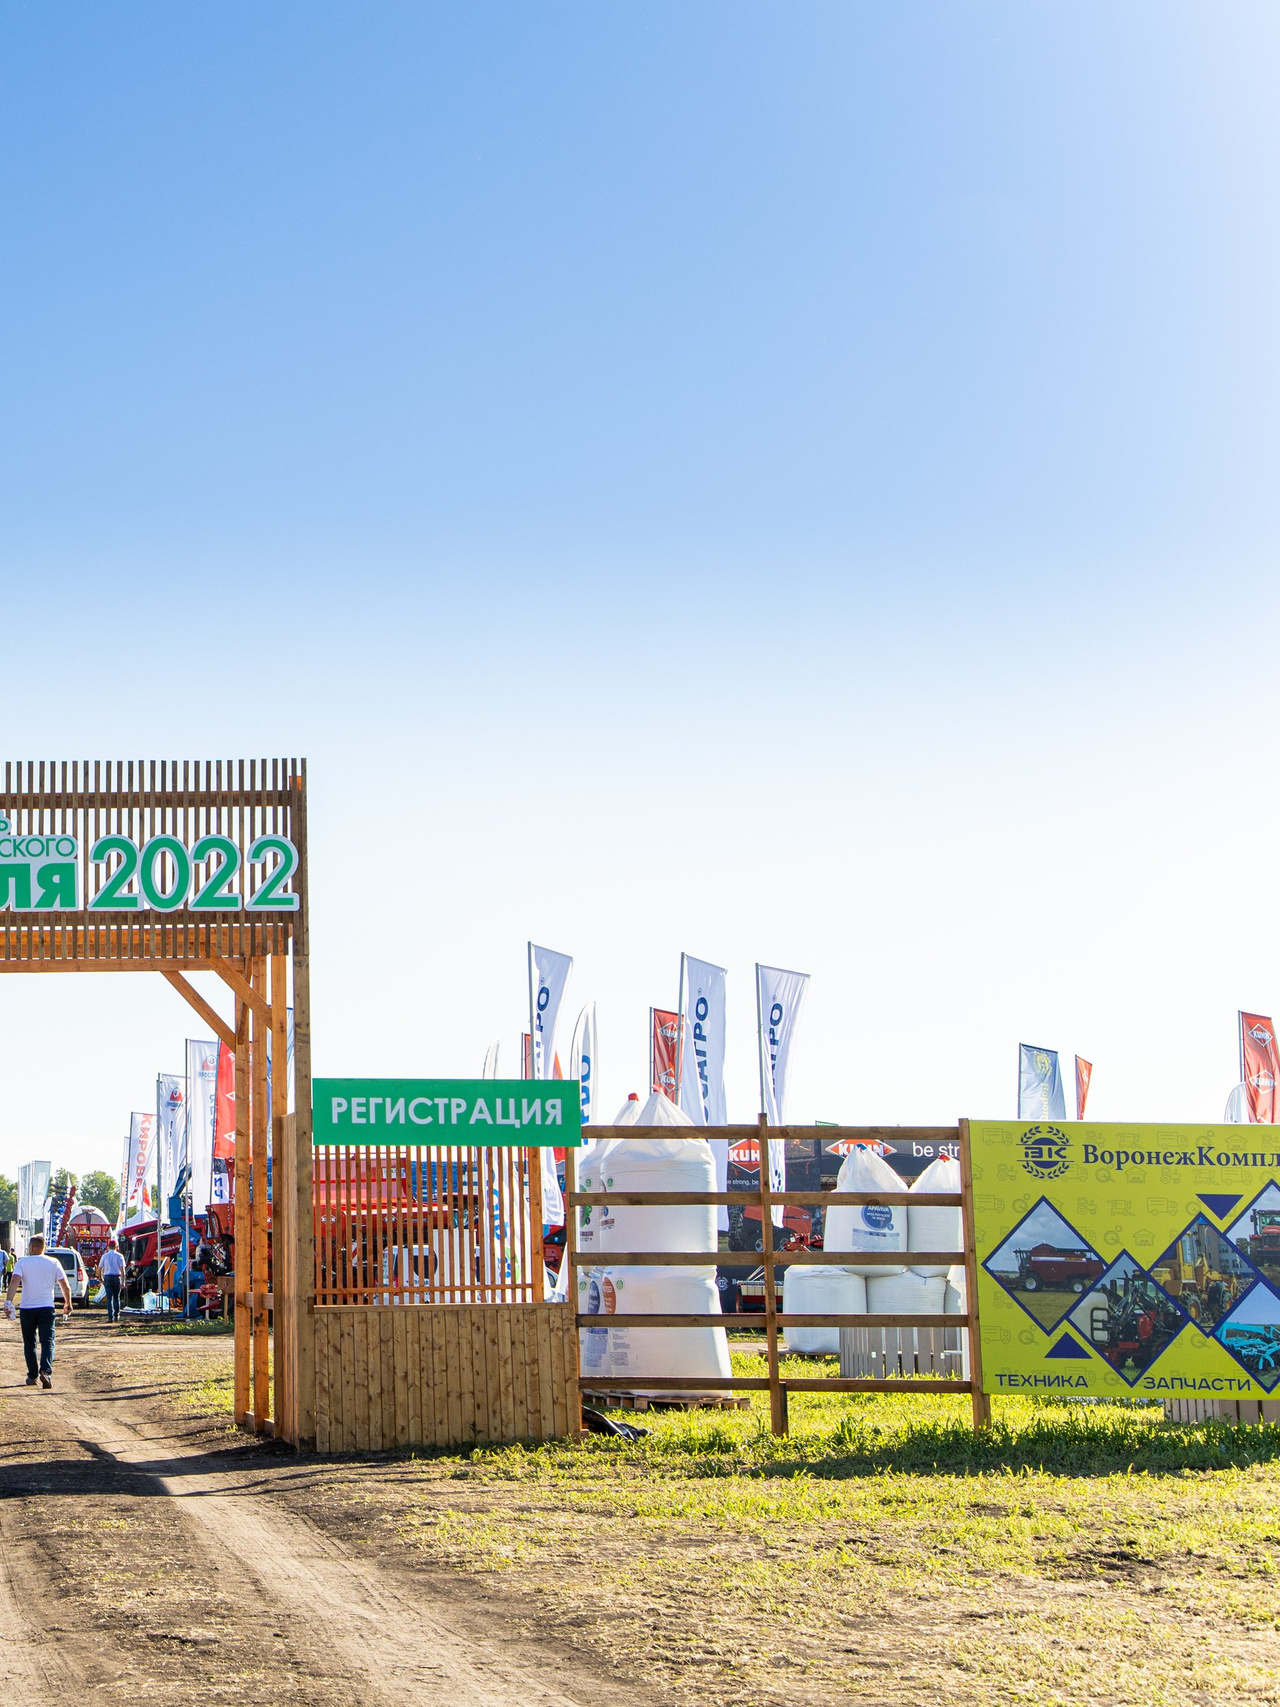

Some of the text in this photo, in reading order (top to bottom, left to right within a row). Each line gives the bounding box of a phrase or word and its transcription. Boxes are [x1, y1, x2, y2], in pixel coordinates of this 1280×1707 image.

[91, 837, 294, 908] 2022
[661, 1074, 675, 1085] KUH
[331, 1097, 562, 1128] РЕГИСТРАЦИЯ
[728, 1149, 760, 1162] KUH
[912, 1142, 960, 1157] be str
[732, 1178, 751, 1187] strong,
[995, 1373, 1089, 1388] ТЕХНИКА
[1143, 1376, 1251, 1392] ЗАПЧАСТИ
